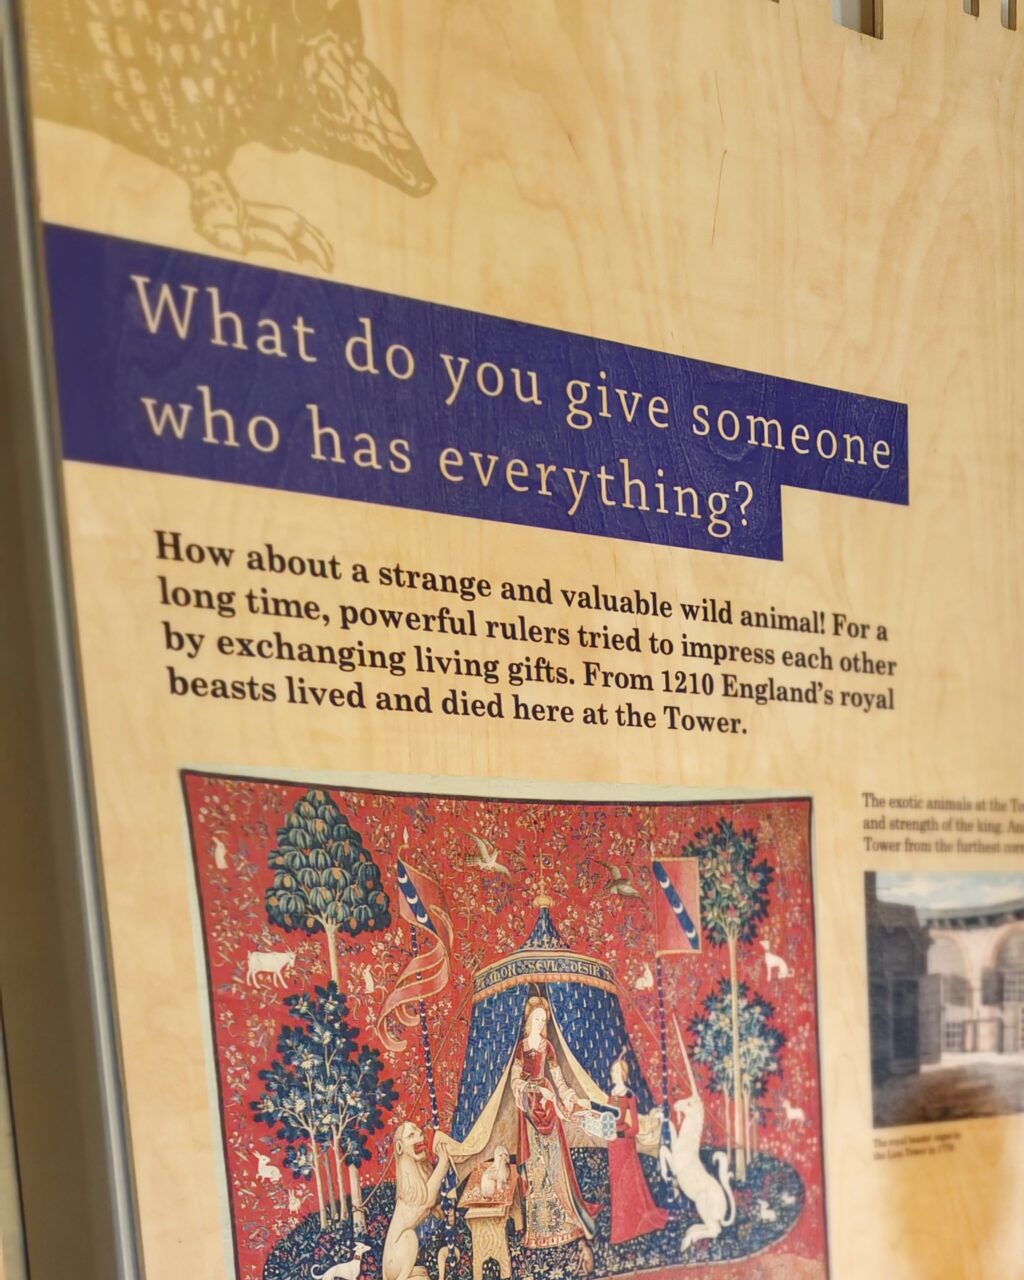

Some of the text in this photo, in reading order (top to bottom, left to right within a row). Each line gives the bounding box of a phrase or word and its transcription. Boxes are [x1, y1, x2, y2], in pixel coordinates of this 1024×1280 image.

[133, 275, 893, 469] What do you give someone
[142, 386, 754, 538] who has everything?
[156, 530, 887, 641] How about a strange and valuable wild animal! For a
[160, 575, 896, 676] long time, powerful rulers tried to impress each other
[163, 621, 894, 712] by exchanging living gifts. From 1210 England's royal
[168, 666, 747, 734] beasts lived and died here at the Tower.
[861, 792, 886, 808] The
[888, 795, 923, 809] exotic
[926, 796, 973, 811] animals
[974, 799, 988, 812] at
[988, 797, 1007, 812] the
[862, 816, 886, 830] and
[888, 818, 939, 834] strength
[941, 818, 954, 831] of
[954, 818, 974, 832] the
